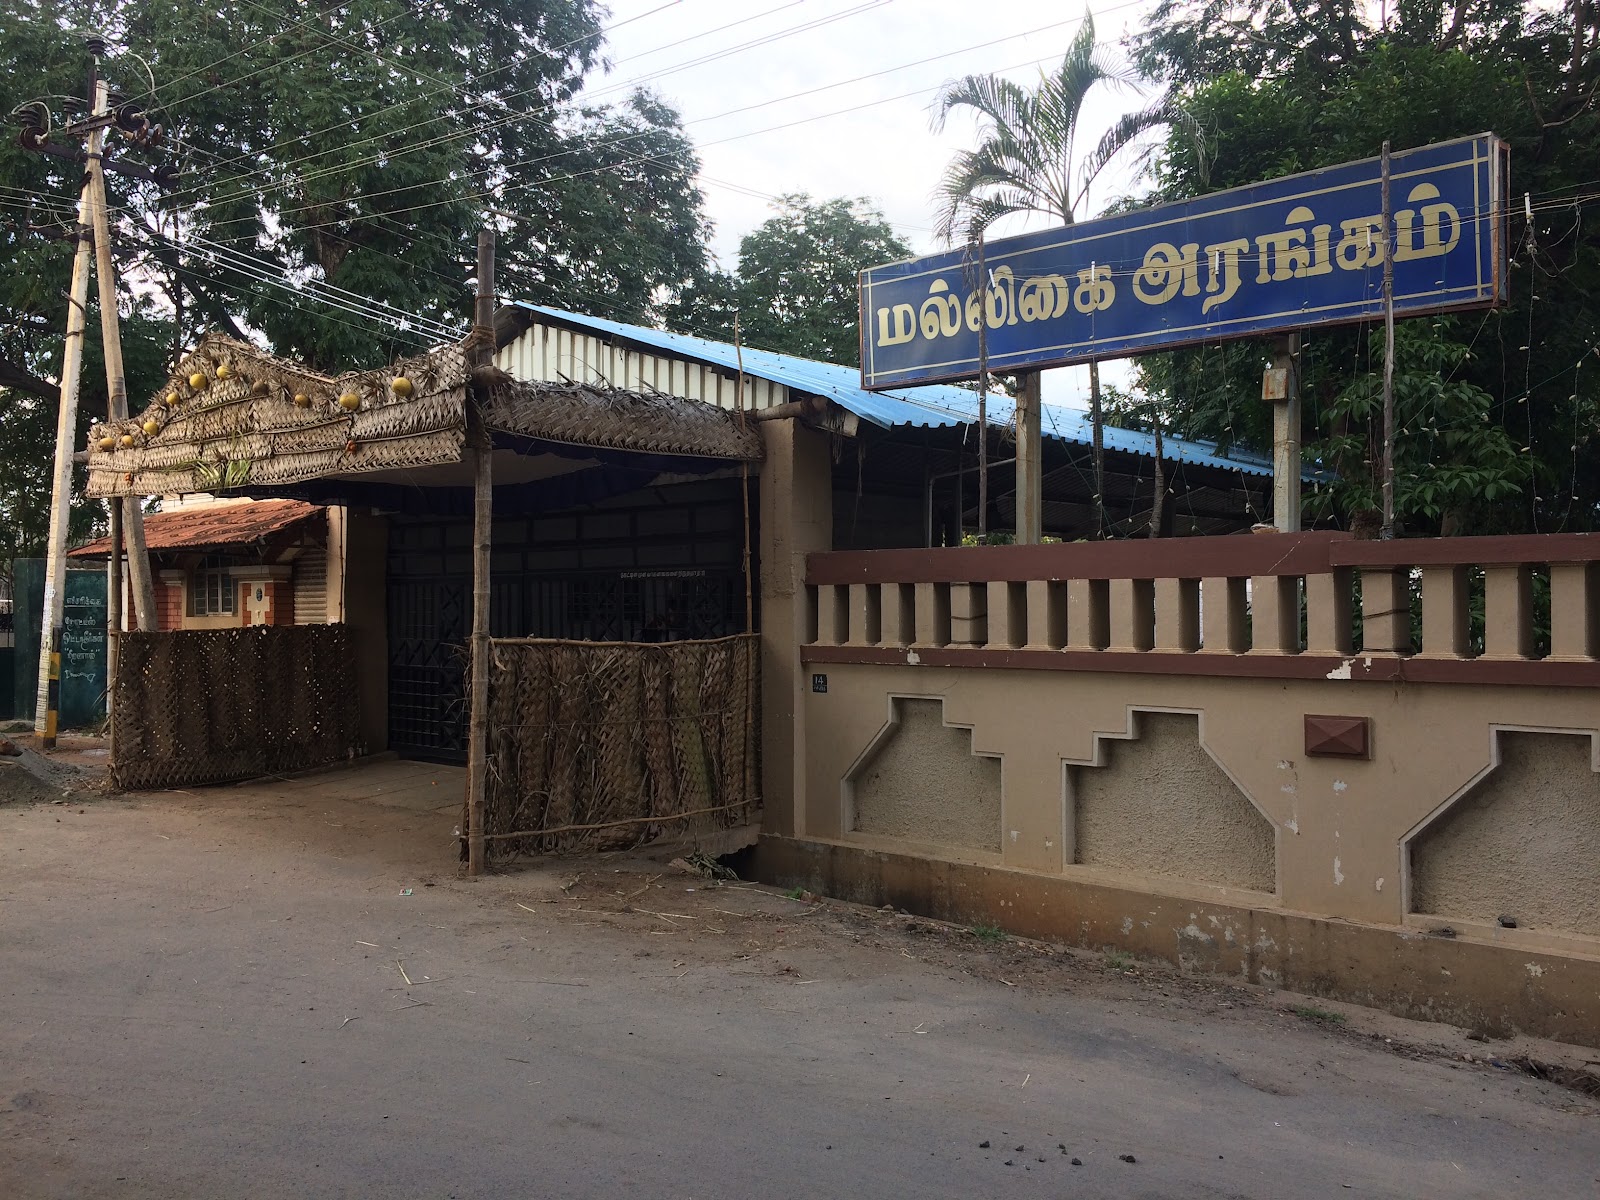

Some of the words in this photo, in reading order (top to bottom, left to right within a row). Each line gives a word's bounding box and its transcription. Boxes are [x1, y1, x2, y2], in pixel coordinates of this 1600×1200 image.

[877, 264, 1116, 347] மல்லிகை
[1132, 182, 1461, 315] அரங்கம்
[815, 676, 824, 685] 14
